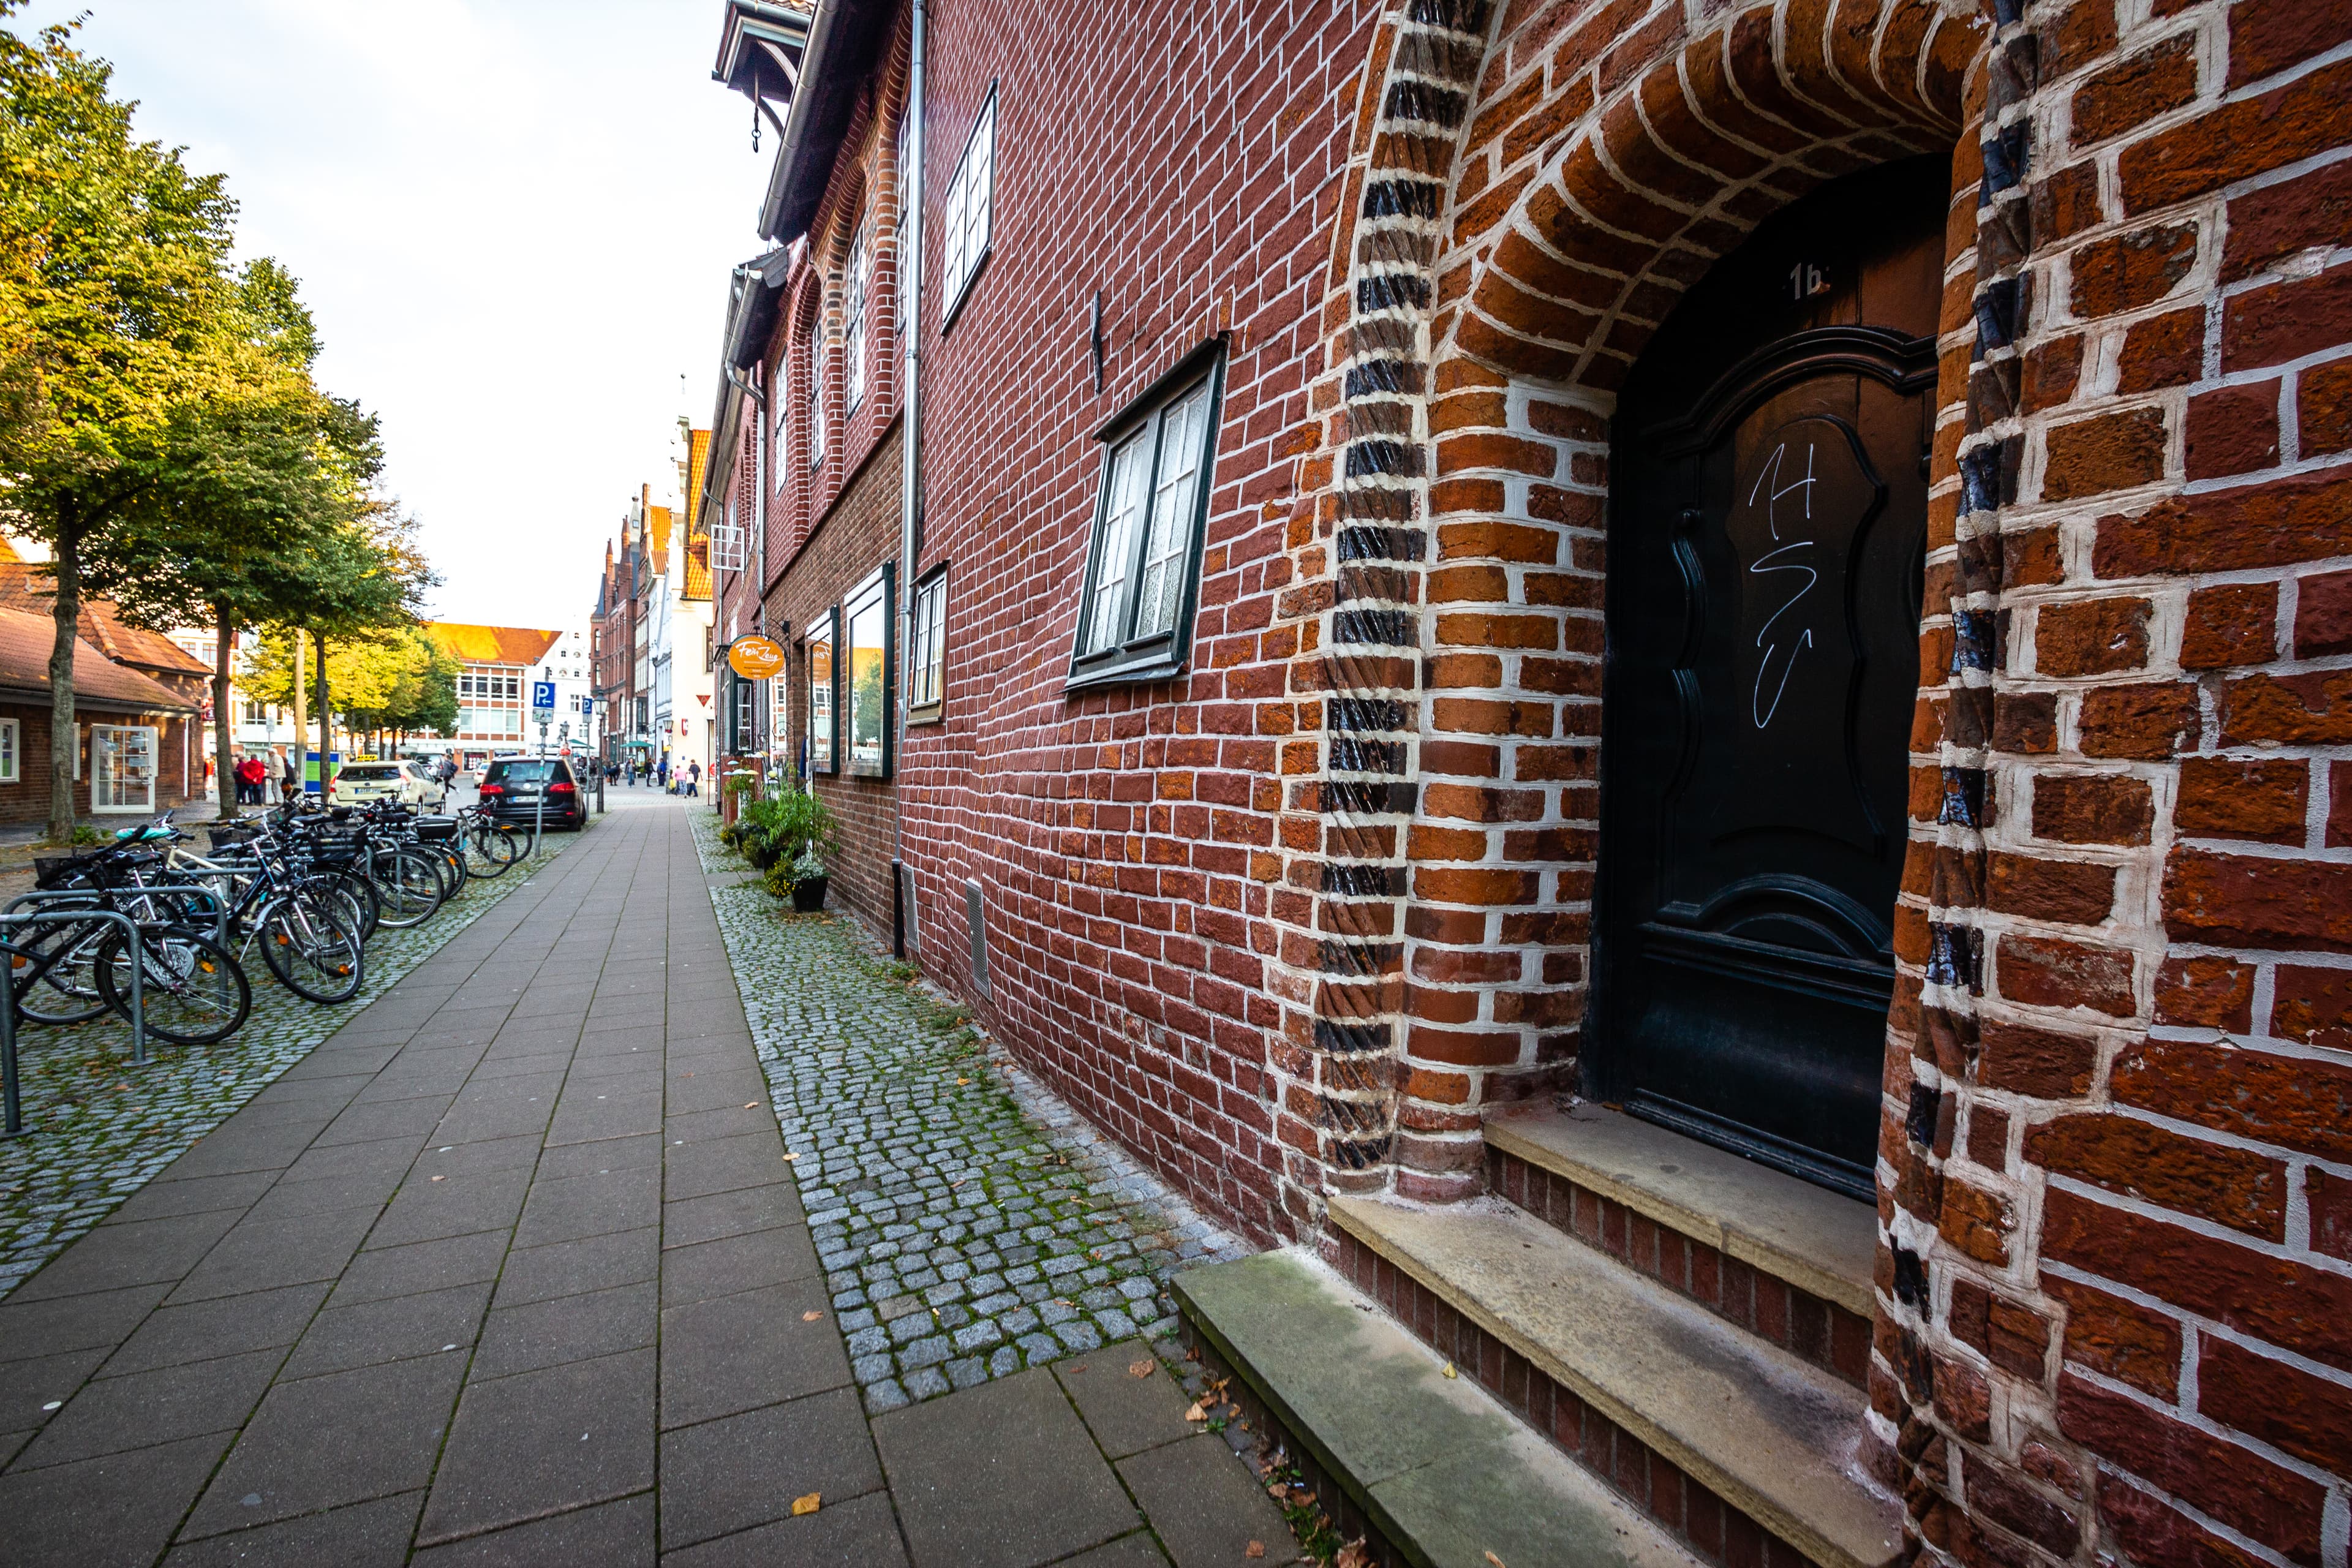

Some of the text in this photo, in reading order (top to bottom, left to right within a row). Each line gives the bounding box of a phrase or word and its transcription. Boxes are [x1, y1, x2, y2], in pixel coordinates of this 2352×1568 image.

[1790, 262, 1821, 300] 1b
[536, 685, 549, 704] P
[584, 700, 590, 710] P
